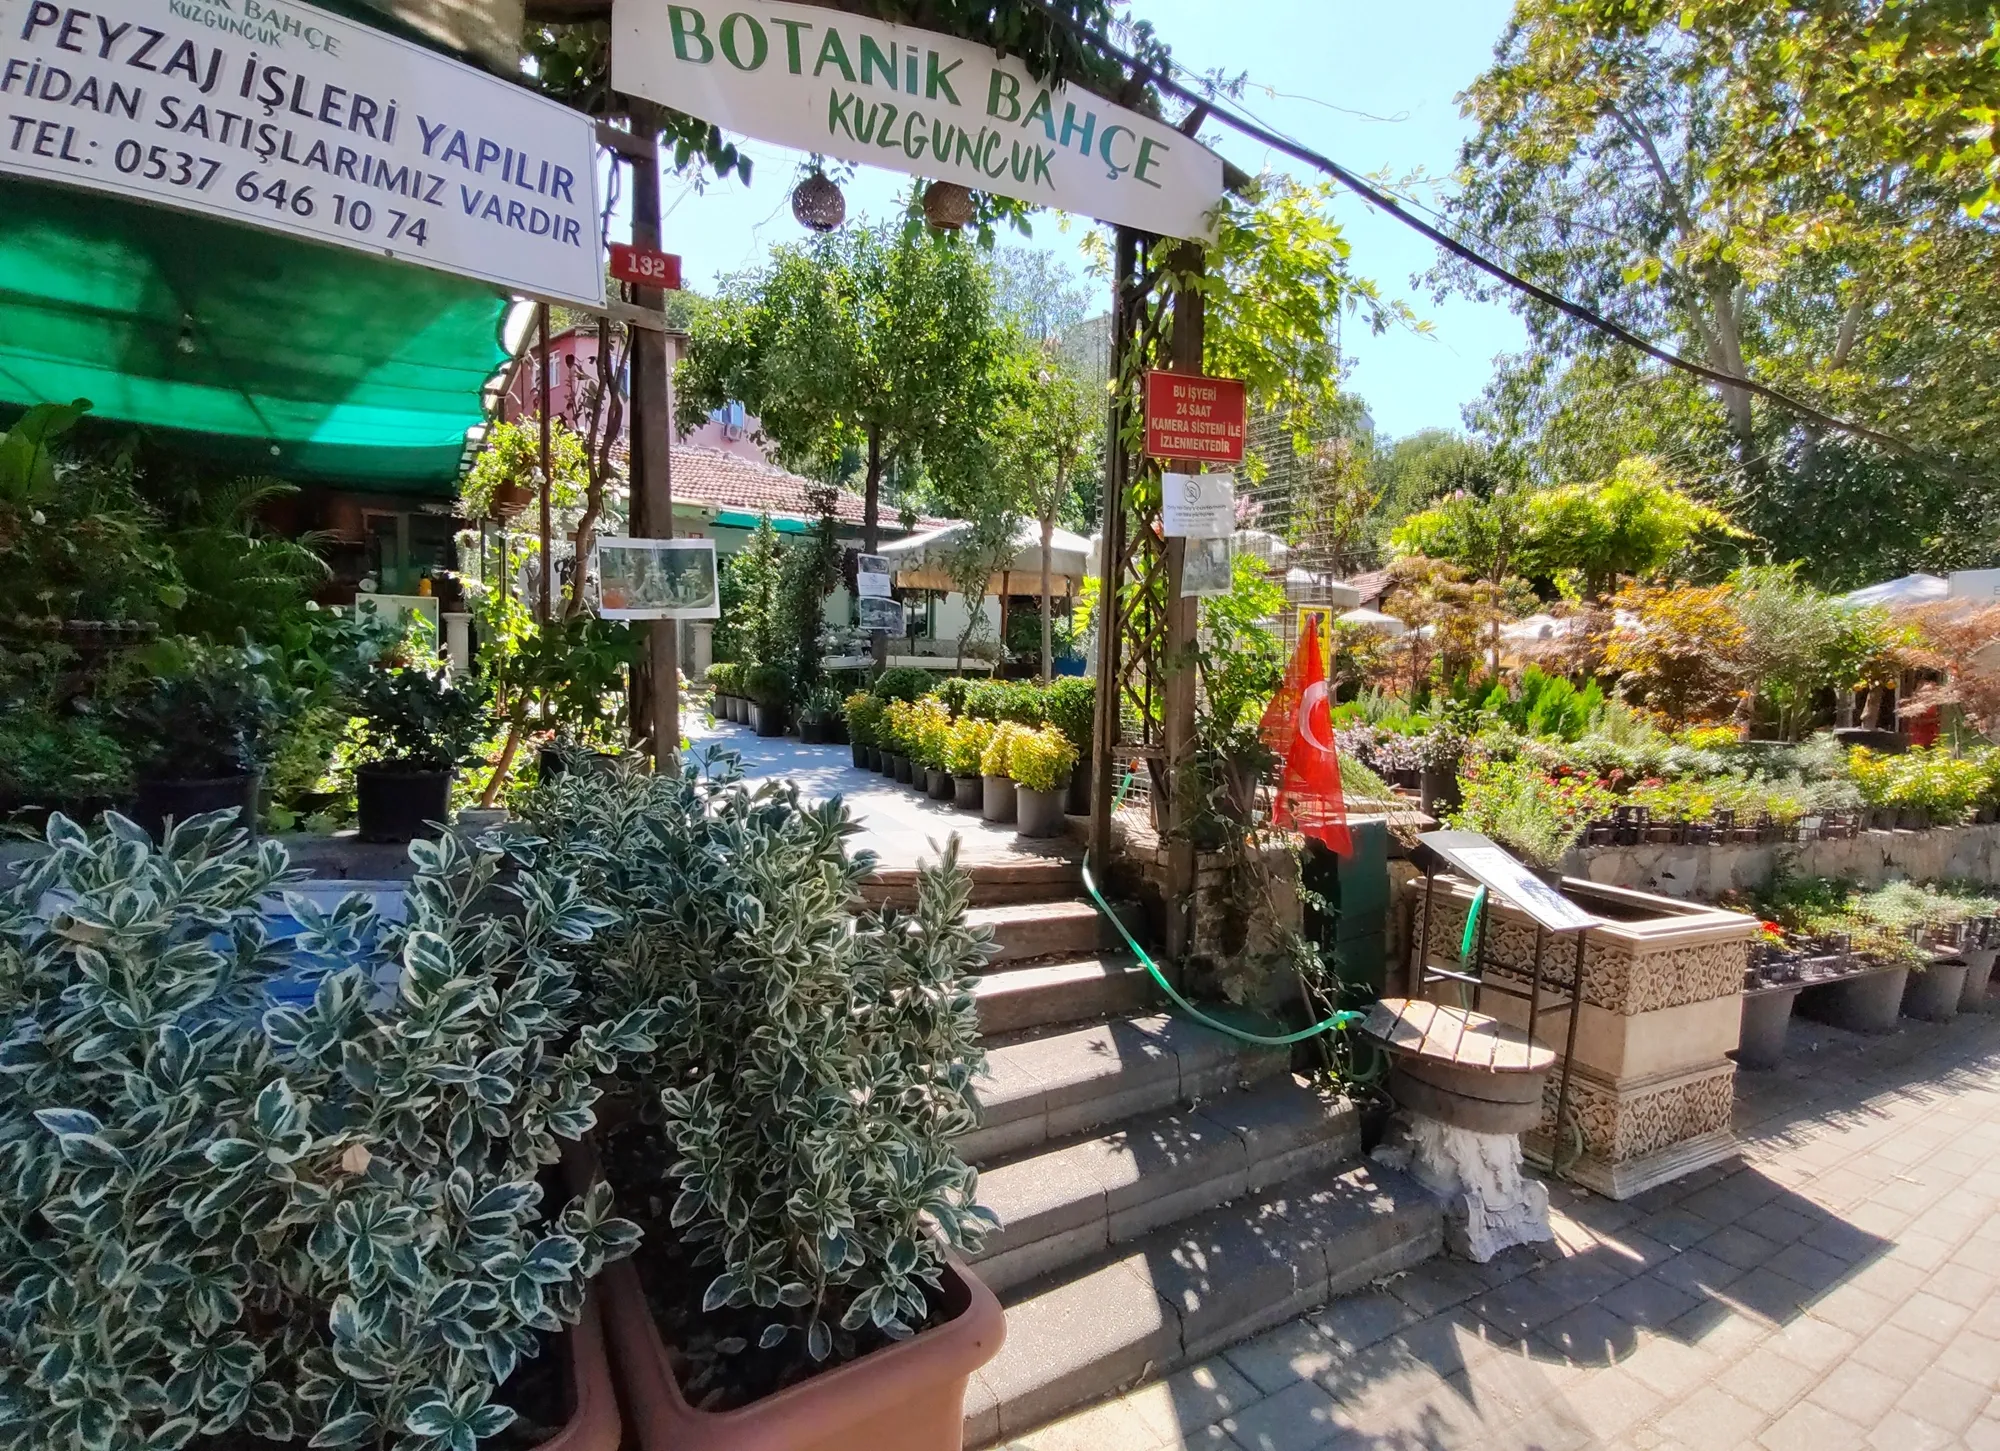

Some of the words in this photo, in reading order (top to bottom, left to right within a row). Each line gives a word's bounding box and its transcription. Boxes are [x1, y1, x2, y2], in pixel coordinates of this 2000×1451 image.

[169, 0, 281, 48] KUZGUNCUK
[244, 0, 341, 58] BAHÇE
[20, 1, 223, 95] PEYZAJ
[241, 52, 399, 143] İŞLERİ
[416, 115, 576, 203] YAPILIR
[986, 67, 1170, 190] BAHÇE
[1, 57, 142, 120] FİDAN
[156, 95, 445, 206] SATIŞLARIMIZ
[459, 183, 581, 248] VARDIR
[828, 87, 1056, 192] KUZGUNCUK
[9, 115, 98, 166] TEL:
[114, 139, 225, 191] 0537
[235, 170, 315, 217] 646
[332, 194, 373, 231] 10
[387, 210, 428, 247] 74
[628, 253, 665, 279] 132
[1173, 385, 1186, 398] BU
[1188, 384, 1217, 402] İŞYERİ
[1176, 403, 1188, 415] 24
[1189, 405, 1212, 417] SAAT
[1151, 417, 1189, 433] KAMERA
[1191, 420, 1226, 436] SİSTEMİ
[1228, 422, 1241, 437] İLE
[1160, 433, 1230, 453] İZLENMEKTEDİR
